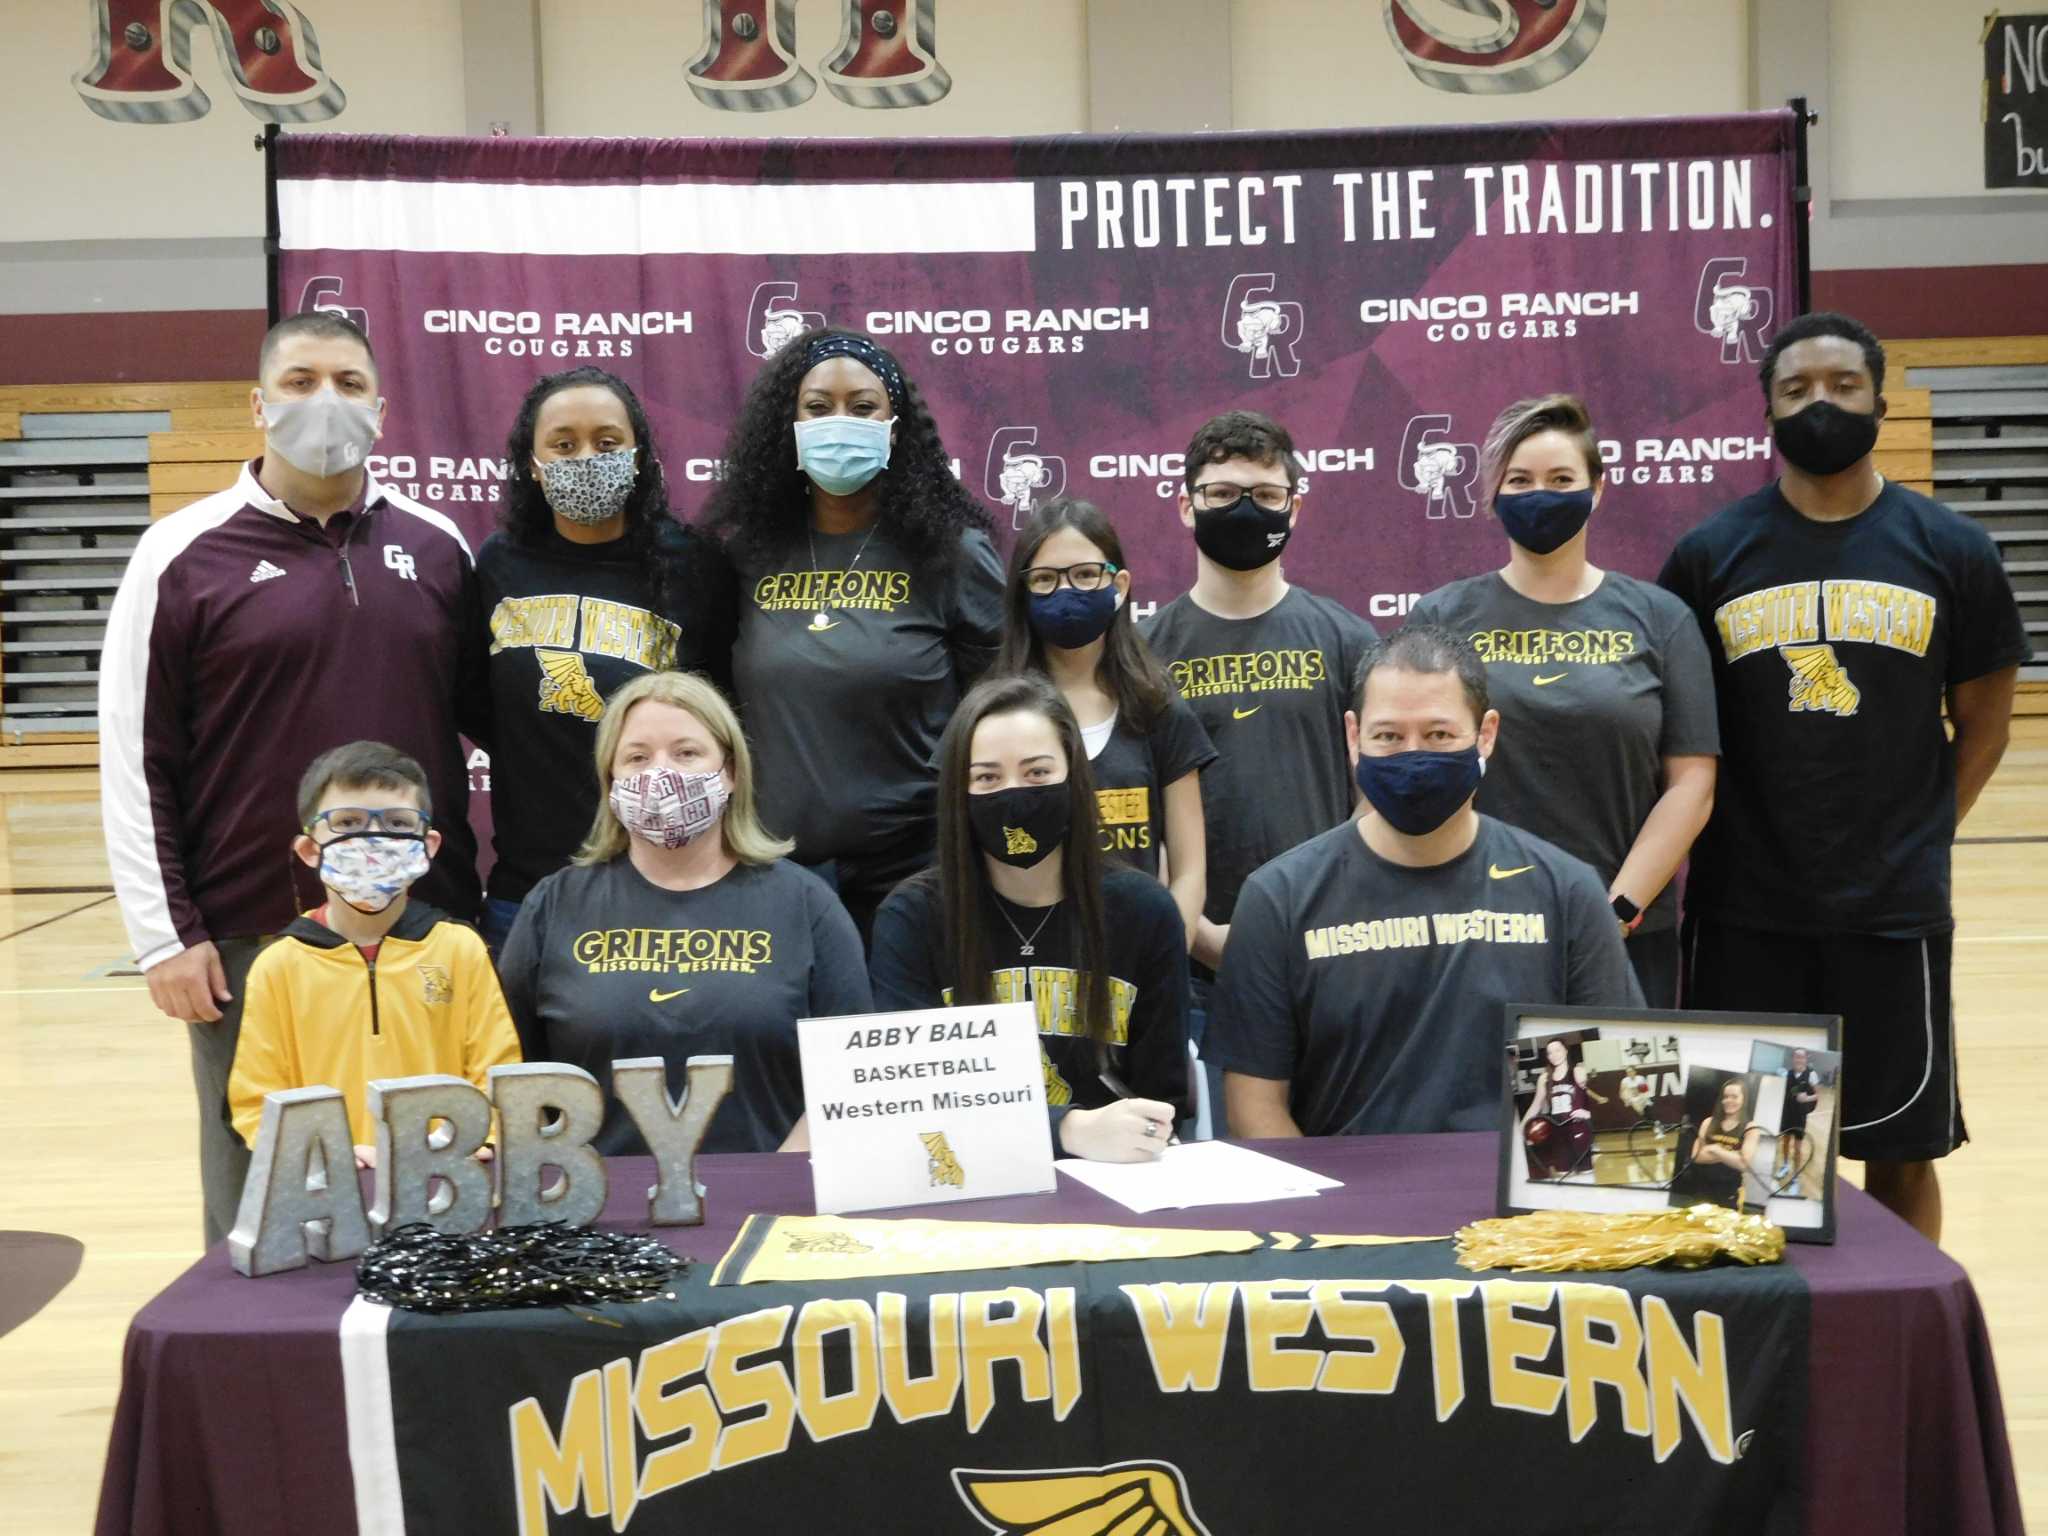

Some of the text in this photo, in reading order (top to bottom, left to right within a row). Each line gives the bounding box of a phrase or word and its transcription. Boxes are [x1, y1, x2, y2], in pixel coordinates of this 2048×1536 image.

[1060, 159, 1773, 250] PROTECT THE TRADITION.
[865, 306, 1149, 335] CINCO RANCH
[1360, 291, 1639, 323] CINCO RANCH
[423, 309, 693, 336] CINCO RANCH
[1426, 318, 1577, 343] COUGARS
[484, 337, 634, 358] COUGARS
[930, 335, 1084, 356] COUGARS
[1292, 447, 1375, 473] NCH
[1635, 436, 1771, 463] RANCH
[429, 456, 508, 481] RAN
[1089, 453, 1187, 478] CINC
[1609, 464, 1714, 485] UGARS
[385, 482, 501, 502] UGARS
[754, 570, 910, 605] GRIFFONS
[1714, 579, 1937, 664] MISSOURI WESTERN
[1467, 629, 1633, 660] GRIFFONS
[1167, 650, 1323, 693] GRIFFONS
[573, 928, 772, 965] GRIFFONS
[1304, 909, 1545, 960] MISSOURI WESTERN
[588, 960, 751, 974] MISSOURI WESTERN
[845, 1019, 998, 1050] ABBY BALA
[853, 1057, 996, 1084] BASKETBALL
[821, 1085, 1034, 1122] Western Missouri
[227, 1054, 735, 1277] ABBY
[508, 1278, 1735, 1536] MISSOURI WESTERN
